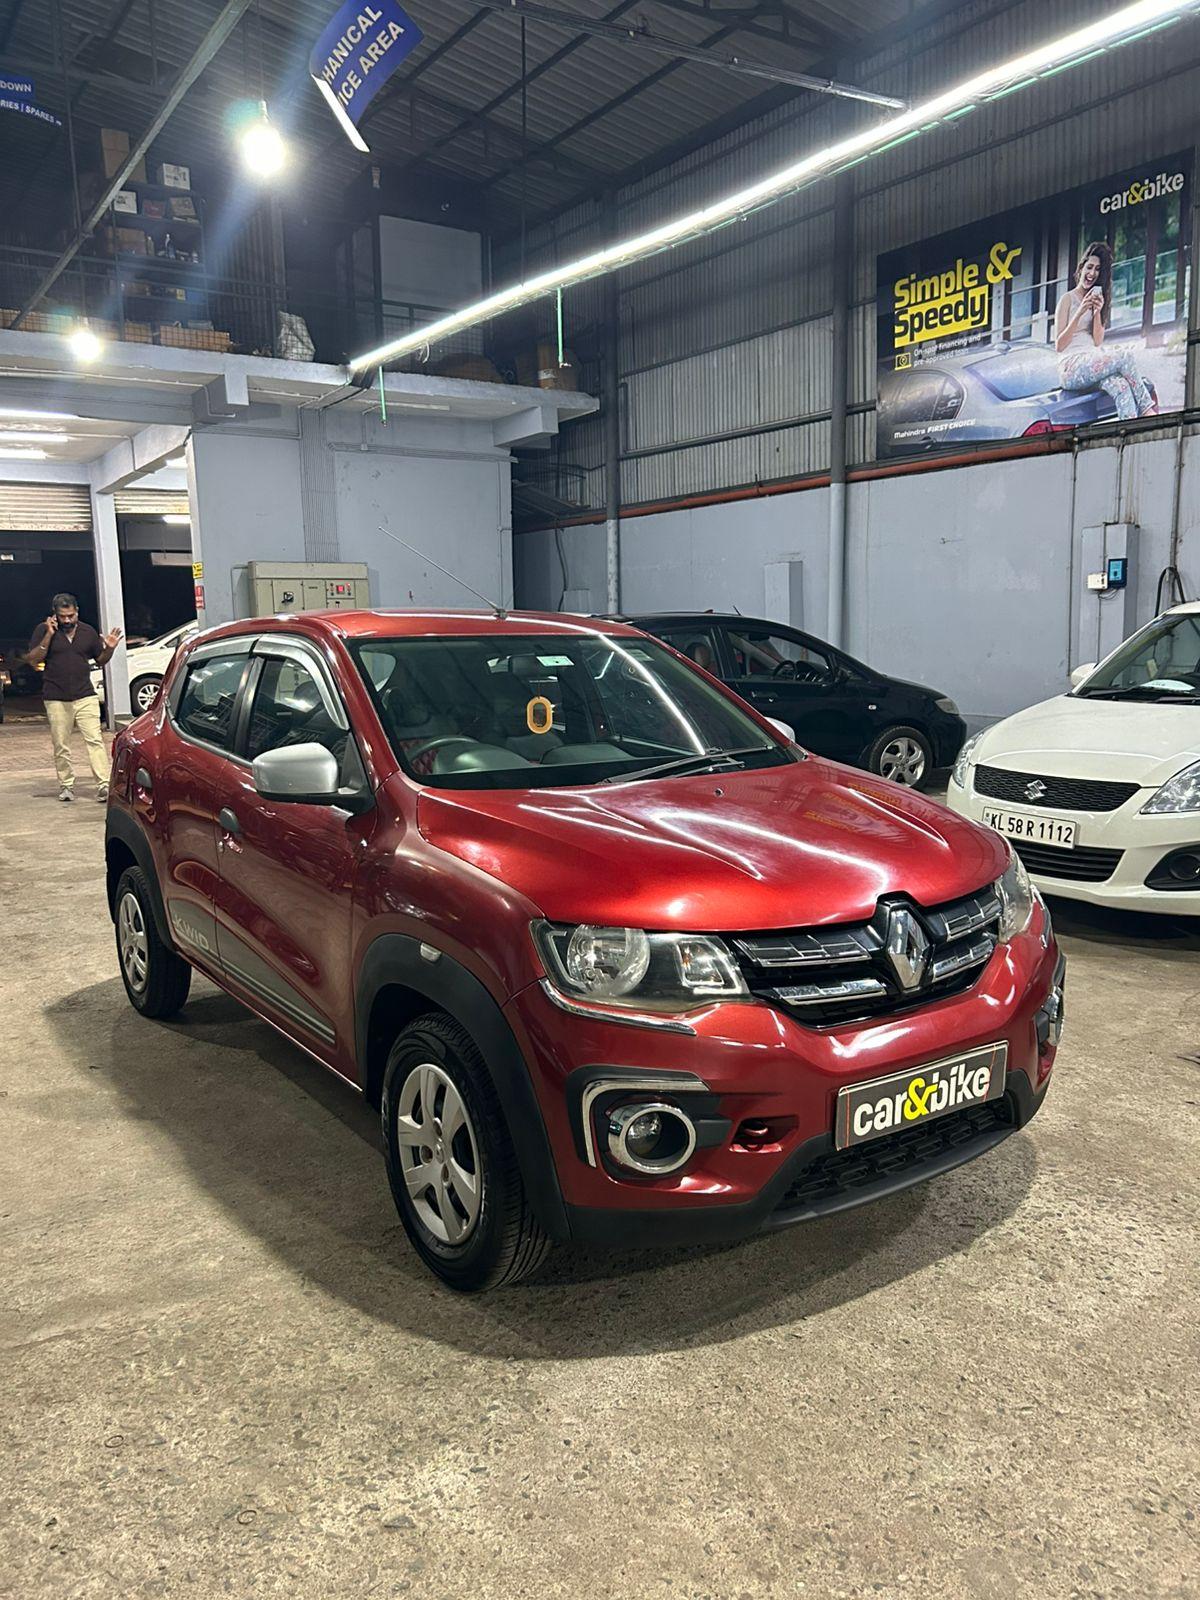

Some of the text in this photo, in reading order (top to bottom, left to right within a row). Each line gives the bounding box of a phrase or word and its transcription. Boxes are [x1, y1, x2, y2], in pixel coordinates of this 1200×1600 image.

[337, 21, 405, 106] ICE AREA
[0, 80, 32, 92] DOWN
[0, 99, 55, 123] RIES SPARES
[1099, 173, 1184, 214] car&bike
[894, 242, 1022, 309] Simple &
[894, 288, 986, 341] Speedy
[938, 339, 968, 350] financing
[968, 334, 981, 343] and
[894, 418, 976, 439] Mahindra FIRST CHOICE
[990, 812, 1073, 844] KL 58 R 1112
[853, 1063, 990, 1137] car&bike
